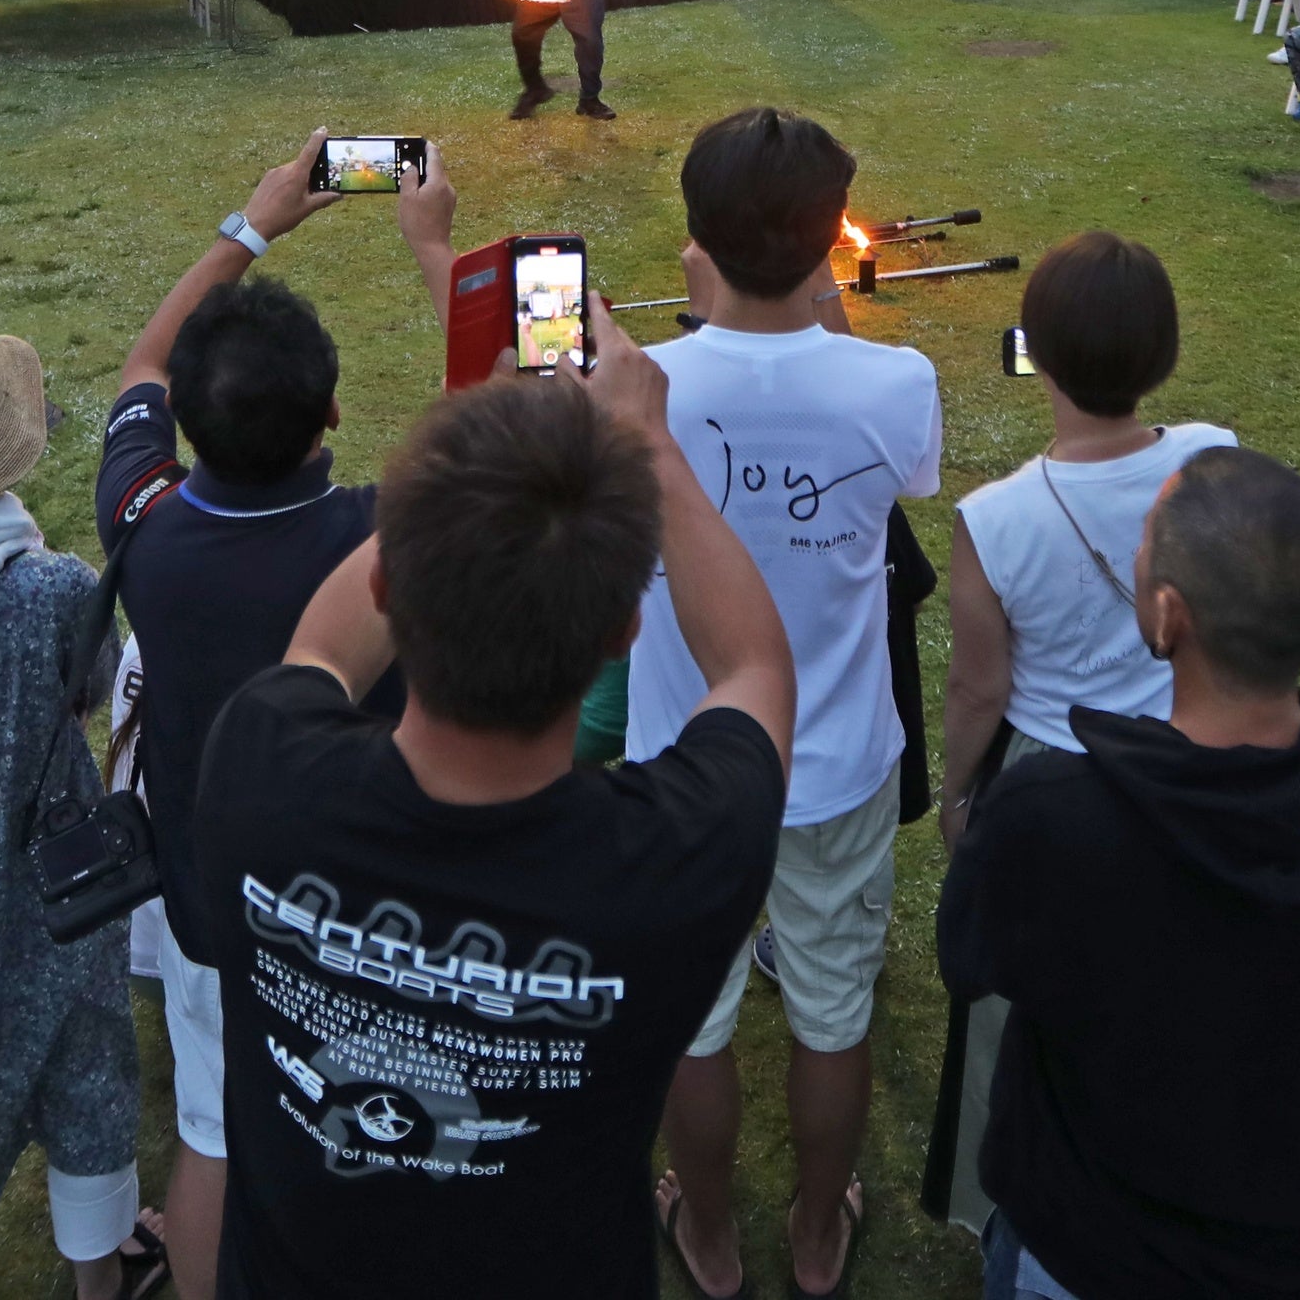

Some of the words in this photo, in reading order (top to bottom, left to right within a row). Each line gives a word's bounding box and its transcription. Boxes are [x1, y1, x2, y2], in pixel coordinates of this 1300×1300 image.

[124, 477, 169, 522] Canon
[790, 536, 811, 548] 846
[815, 531, 857, 550] YAJIRO
[242, 873, 625, 1002] CENTURION
[256, 959, 292, 986] CWSA
[298, 979, 327, 1002] WRS
[332, 997, 370, 1021] GOLD
[376, 1015, 426, 1039] CLASS
[432, 1032, 541, 1062] MEN&WOMEN
[550, 1050, 583, 1062] PRO
[279, 983, 351, 1027] SURF/SKIM
[369, 1027, 430, 1052] OUTLAW
[318, 943, 515, 1018] BOATS
[250, 973, 306, 1016] AMATEUR
[312, 1013, 388, 1054] SURF/SKIM
[407, 1049, 469, 1073] MASTER
[538, 1069, 580, 1079] SKIM
[256, 989, 298, 1024] JUNIOR
[303, 1021, 376, 1064] SURF/SKIM
[385, 1058, 463, 1084] BEGINNER
[470, 1077, 515, 1089] SURF
[539, 1079, 581, 1089] SKIM
[327, 1050, 344, 1066] AT
[349, 1062, 406, 1087] ROTARY
[415, 1079, 468, 1097] PIER88
[279, 1092, 338, 1154] Evolution
[341, 1147, 361, 1162] of
[365, 1151, 396, 1166] the
[402, 1155, 456, 1173] Wake
[461, 1161, 505, 1176] Boat
